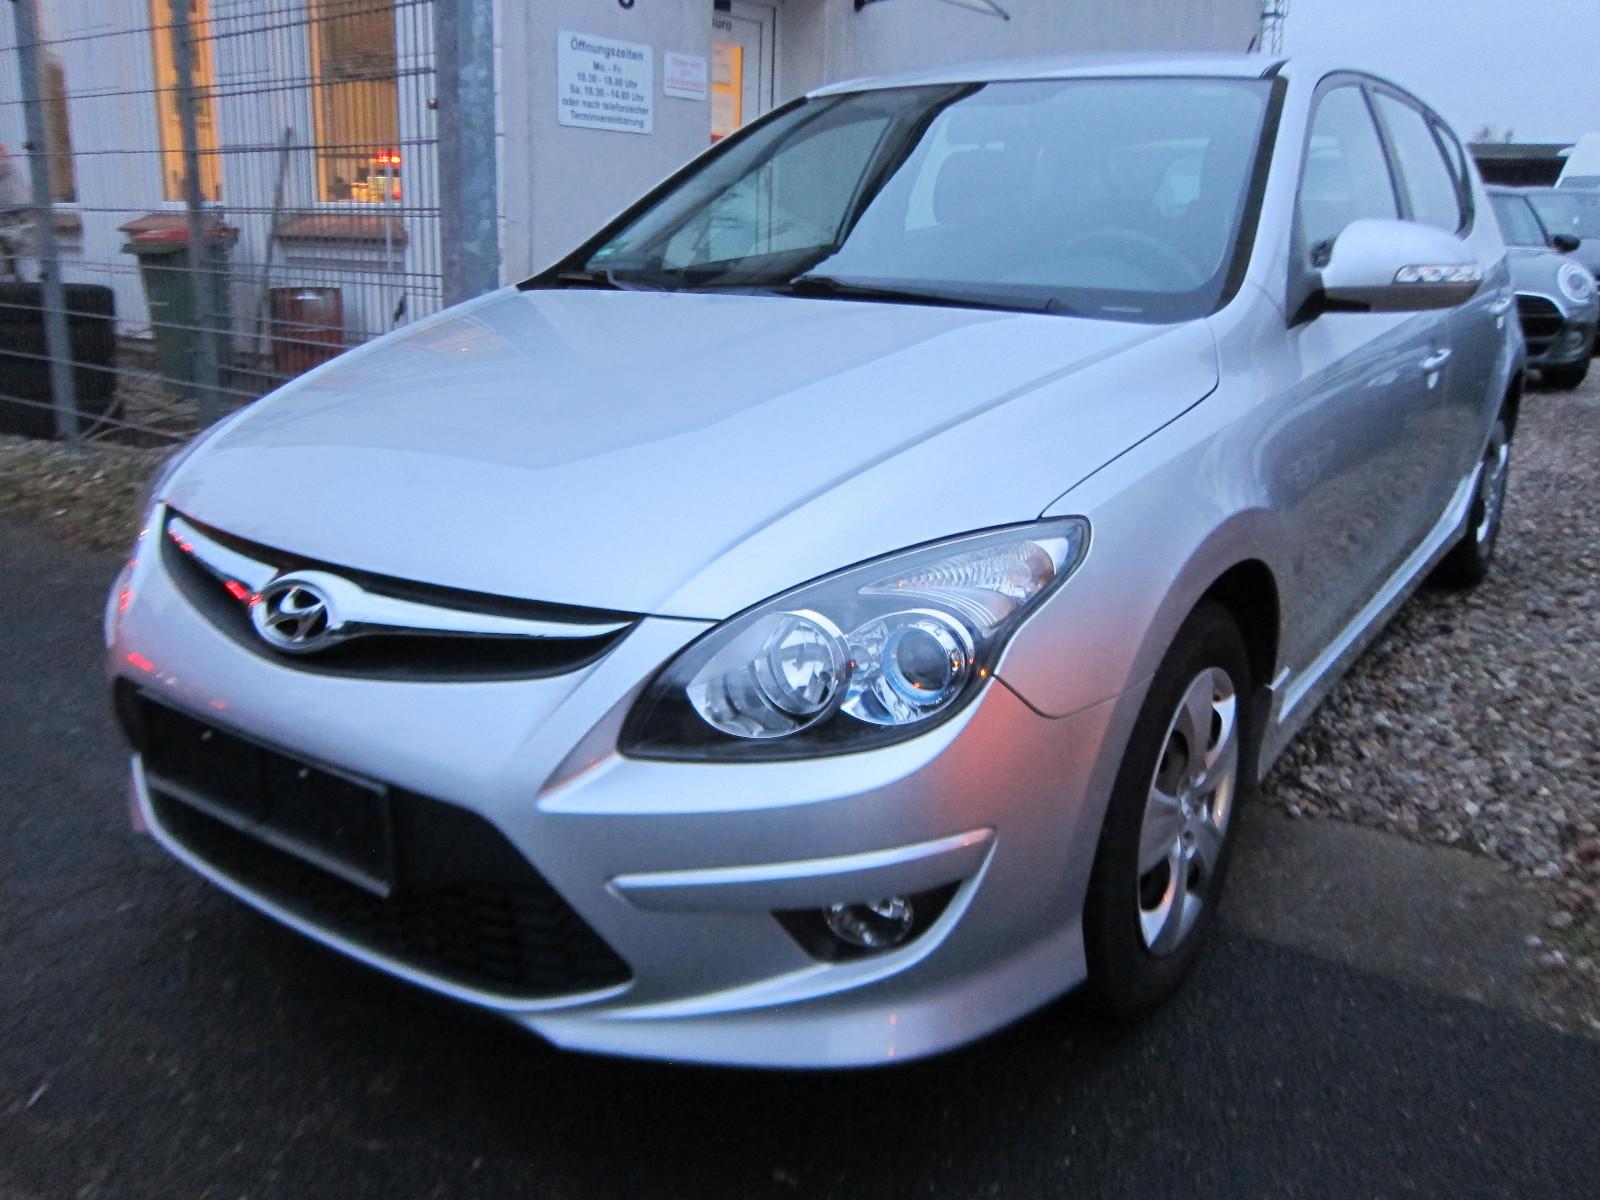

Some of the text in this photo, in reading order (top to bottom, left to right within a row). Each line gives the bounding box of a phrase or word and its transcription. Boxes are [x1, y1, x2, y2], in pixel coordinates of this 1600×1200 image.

[570, 36, 643, 60] Öffnungszeiten
[625, 79, 638, 89] Uhr
[632, 92, 645, 103] Uhr
[561, 98, 649, 115] oder nach telefonischer
[570, 110, 645, 129] Terminvereinbarung
